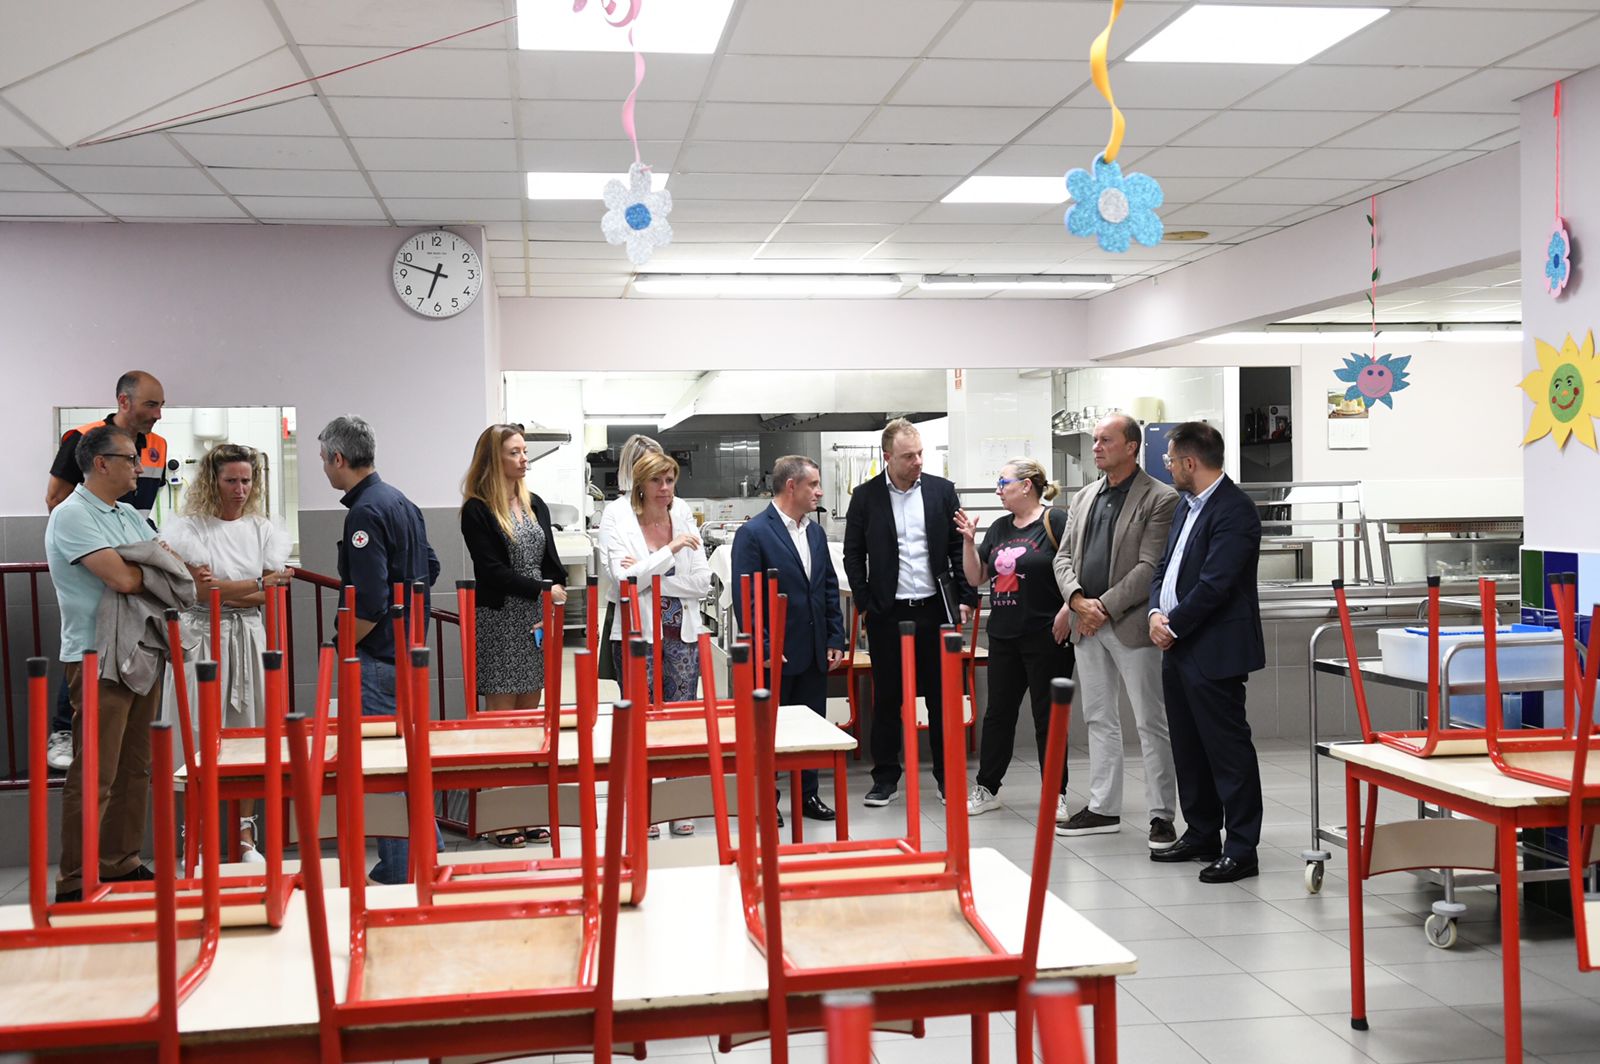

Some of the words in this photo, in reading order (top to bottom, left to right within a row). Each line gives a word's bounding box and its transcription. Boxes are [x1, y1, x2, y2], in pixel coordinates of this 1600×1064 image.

[416, 240, 424, 250] 11
[432, 236, 442, 247] 12
[452, 241, 455, 251] 1
[403, 252, 413, 262] 10
[462, 253, 470, 263] 2
[400, 269, 408, 279] 9
[467, 269, 475, 279] 3
[405, 285, 412, 295] 8
[463, 286, 470, 296] 4
[417, 297, 425, 308] 7
[434, 302, 442, 312] 6
[451, 298, 459, 308] 5
